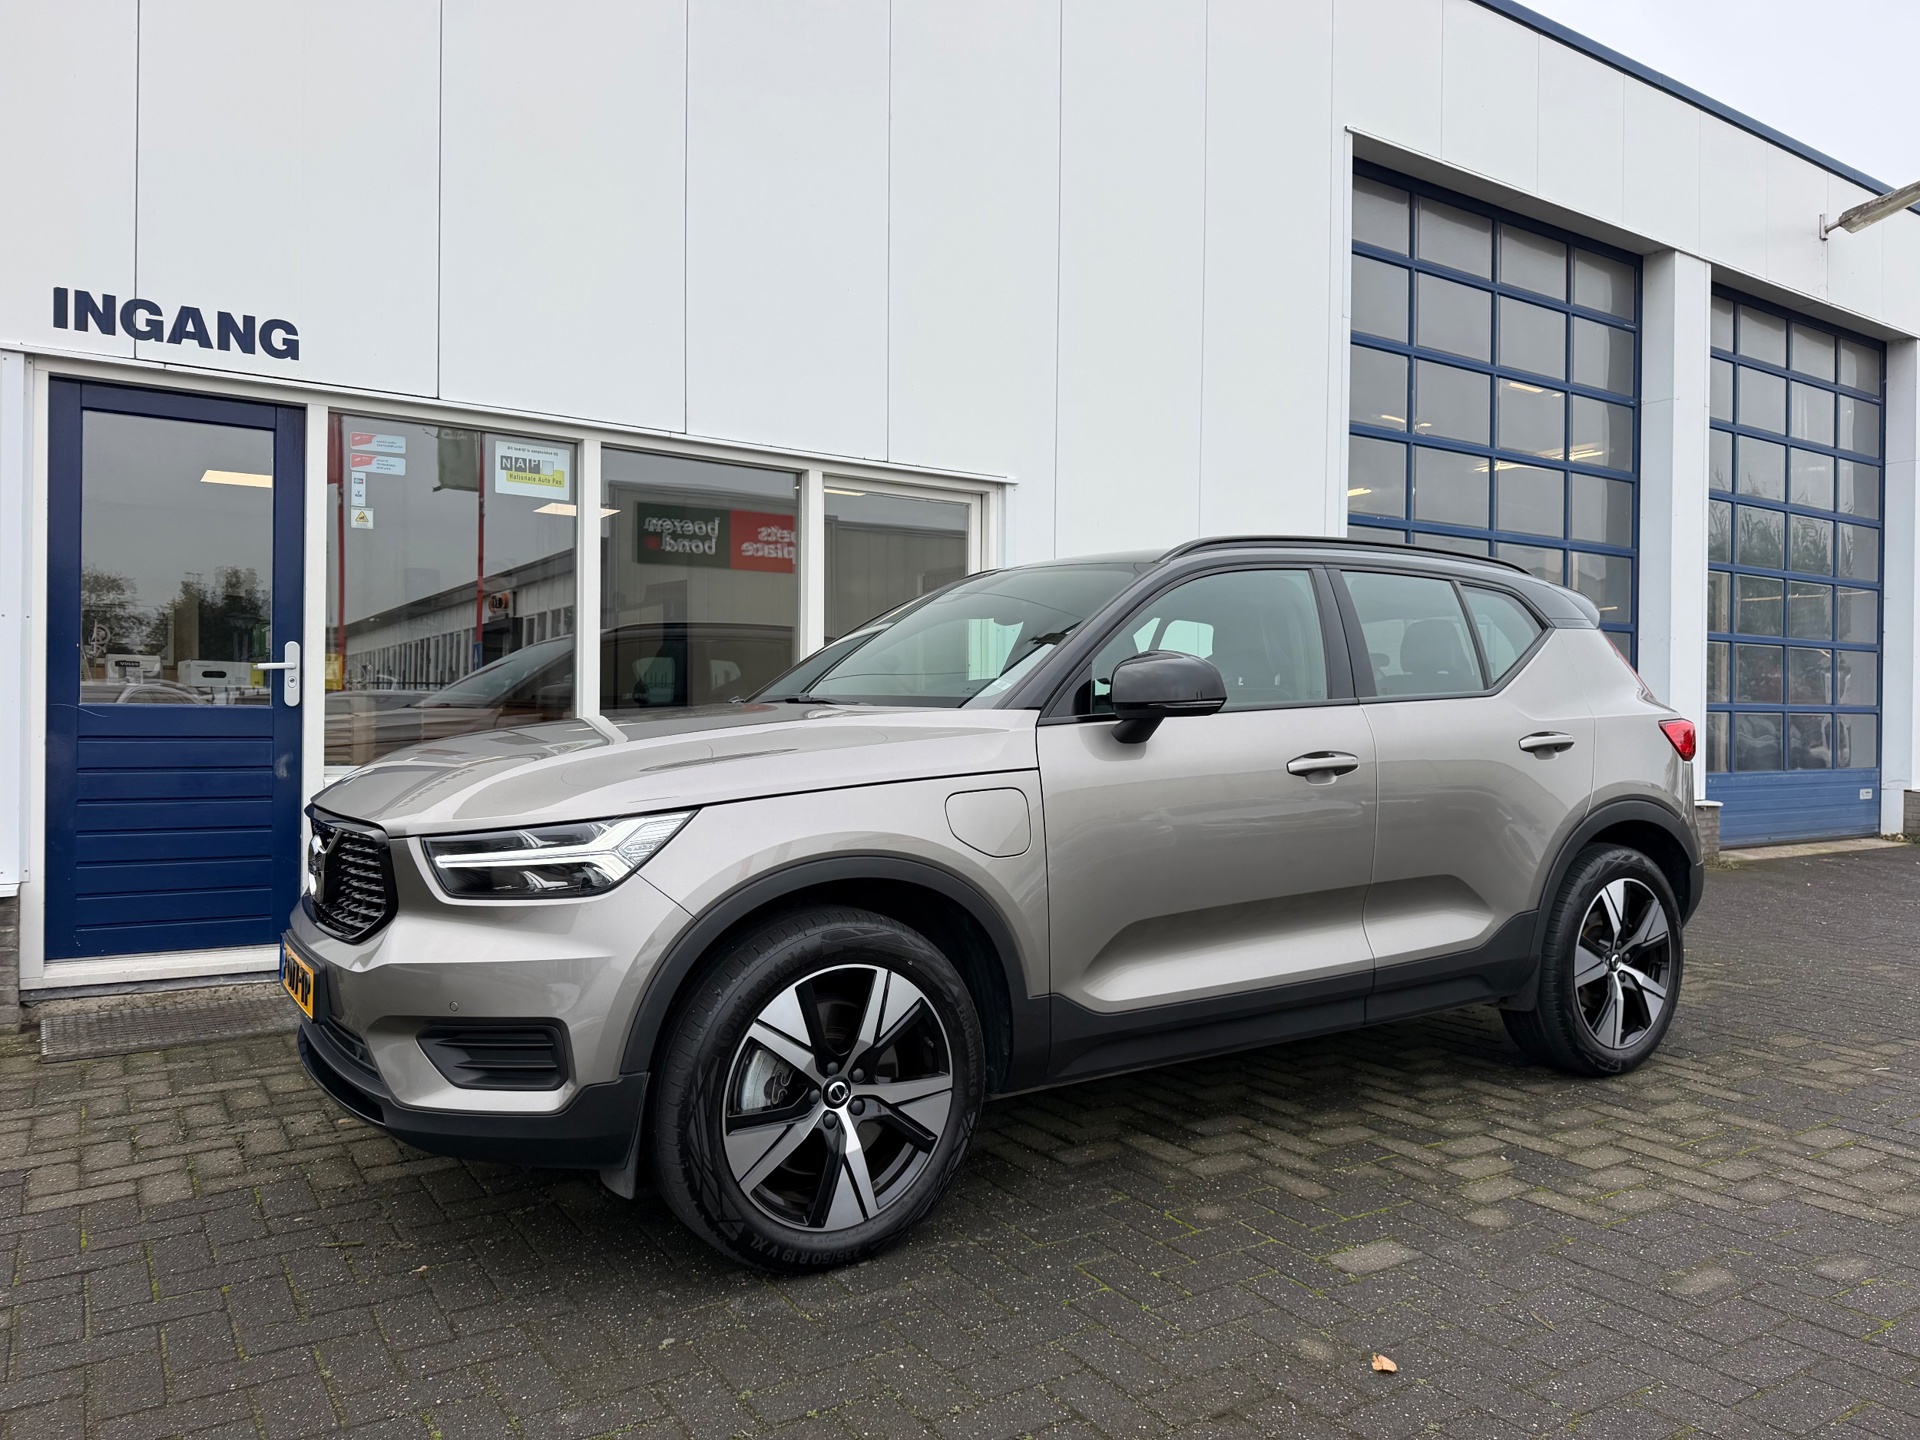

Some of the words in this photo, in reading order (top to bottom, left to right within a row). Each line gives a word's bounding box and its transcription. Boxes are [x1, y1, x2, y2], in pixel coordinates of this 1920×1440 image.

[53, 286, 300, 361] INGANG
[501, 457, 540, 470] NAP
[509, 473, 536, 482] Nationale
[538, 476, 551, 484] Auto
[552, 477, 562, 485] Pas
[715, 950, 799, 1047] Continental
[749, 1233, 769, 1251] XL
[766, 1244, 779, 1258] V
[781, 1248, 797, 1263] 19
[799, 1250, 808, 1264] R
[811, 1247, 861, 1265] 235/50
